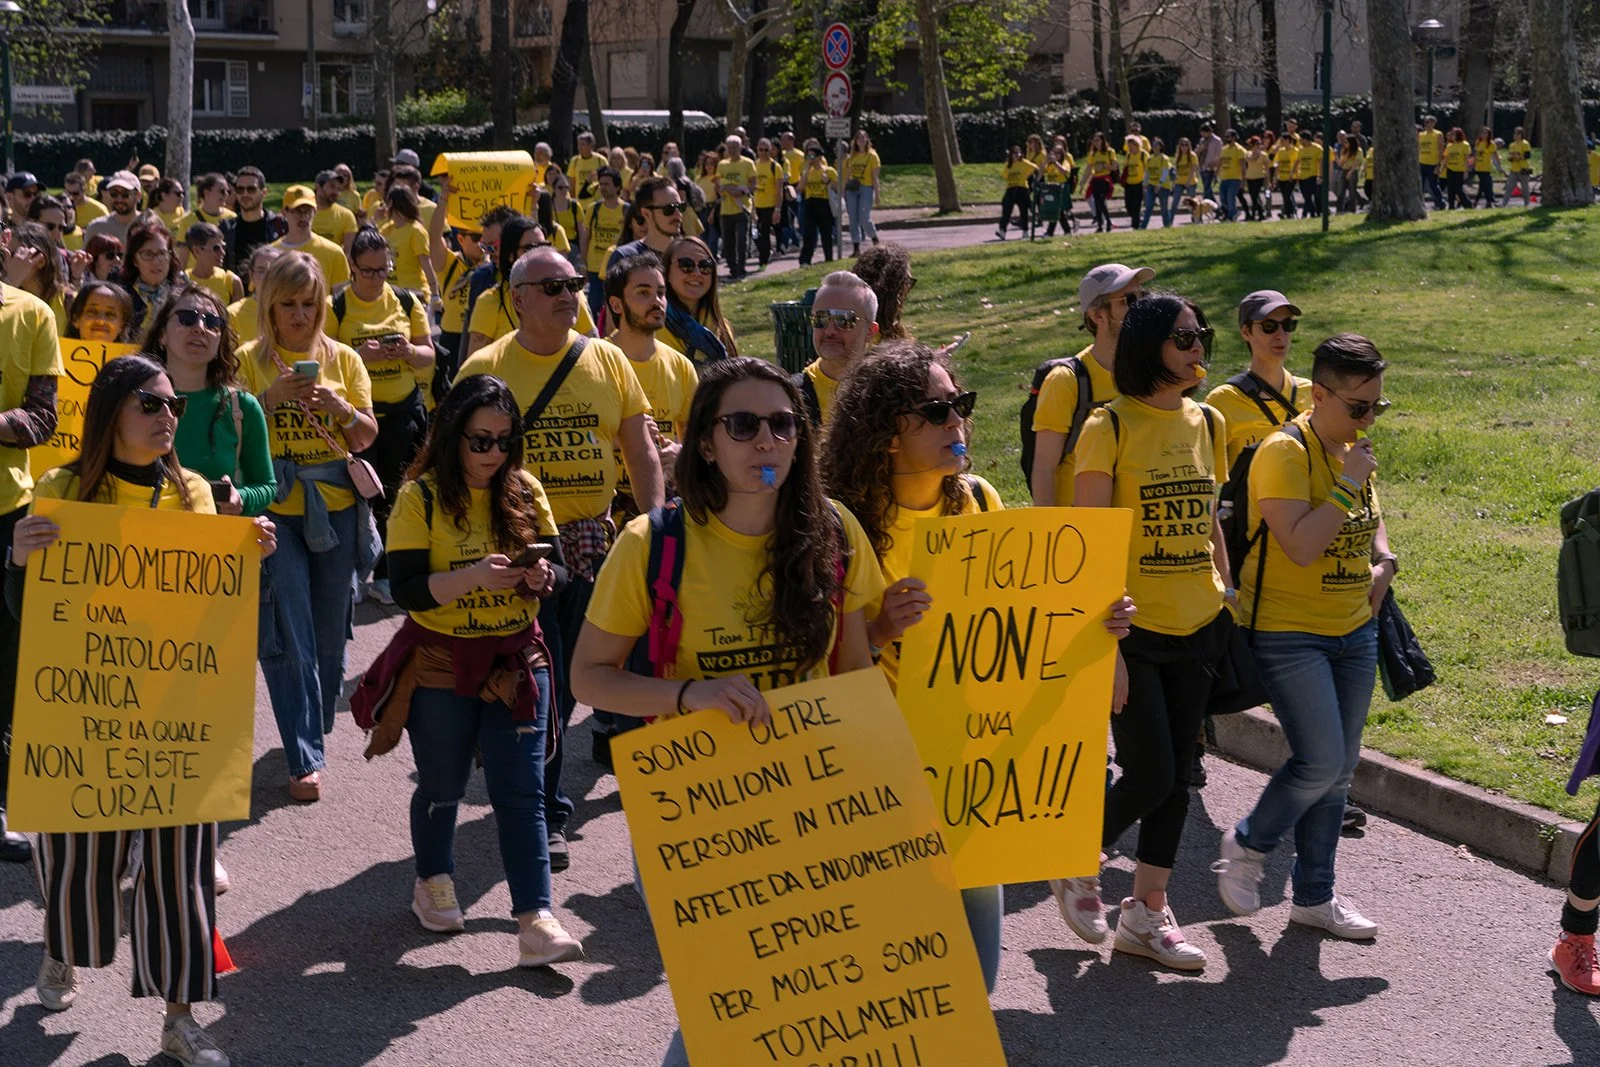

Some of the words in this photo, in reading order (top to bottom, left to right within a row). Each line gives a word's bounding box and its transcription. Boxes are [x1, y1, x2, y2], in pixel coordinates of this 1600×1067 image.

[459, 166, 478, 174] NON
[481, 179, 502, 192] NON
[532, 416, 597, 429] ORLDWIDE
[526, 448, 603, 464] MARCH
[1145, 468, 1170, 481] Team
[926, 526, 957, 555] UN
[1142, 521, 1210, 538] MARC
[38, 541, 244, 597] L'ENDOMETRIOSI
[961, 524, 1086, 597] FIGLIO
[86, 603, 128, 626] UNA
[85, 631, 219, 675] PATOLOGIA
[703, 627, 743, 646] Team
[928, 606, 1037, 688] NON
[34, 666, 141, 709] CRONICA
[82, 716, 122, 741] PER
[152, 720, 212, 742] QUALE
[632, 730, 716, 775] SONO
[749, 696, 840, 745] OLTRE
[966, 711, 1014, 739] UNA
[24, 743, 84, 778] NON
[106, 748, 200, 779] ESISTE
[71, 783, 175, 820] CURA!
[651, 790, 681, 821] 3
[686, 760, 793, 815] MILIONI
[805, 745, 844, 781] LE
[923, 741, 1083, 828] URA!!!
[658, 819, 781, 871] PERSONE
[794, 808, 818, 837] IN
[826, 785, 902, 826] ITALIA
[673, 879, 771, 928] AFFETTE
[767, 870, 804, 897] DA
[805, 831, 947, 890] ENDOMETRIOSI
[749, 904, 861, 959] EPPURE
[709, 988, 760, 1021] PER
[771, 954, 864, 1002] MOLT3
[883, 931, 948, 973] SONO
[753, 984, 954, 1061] TOTALMENTE
